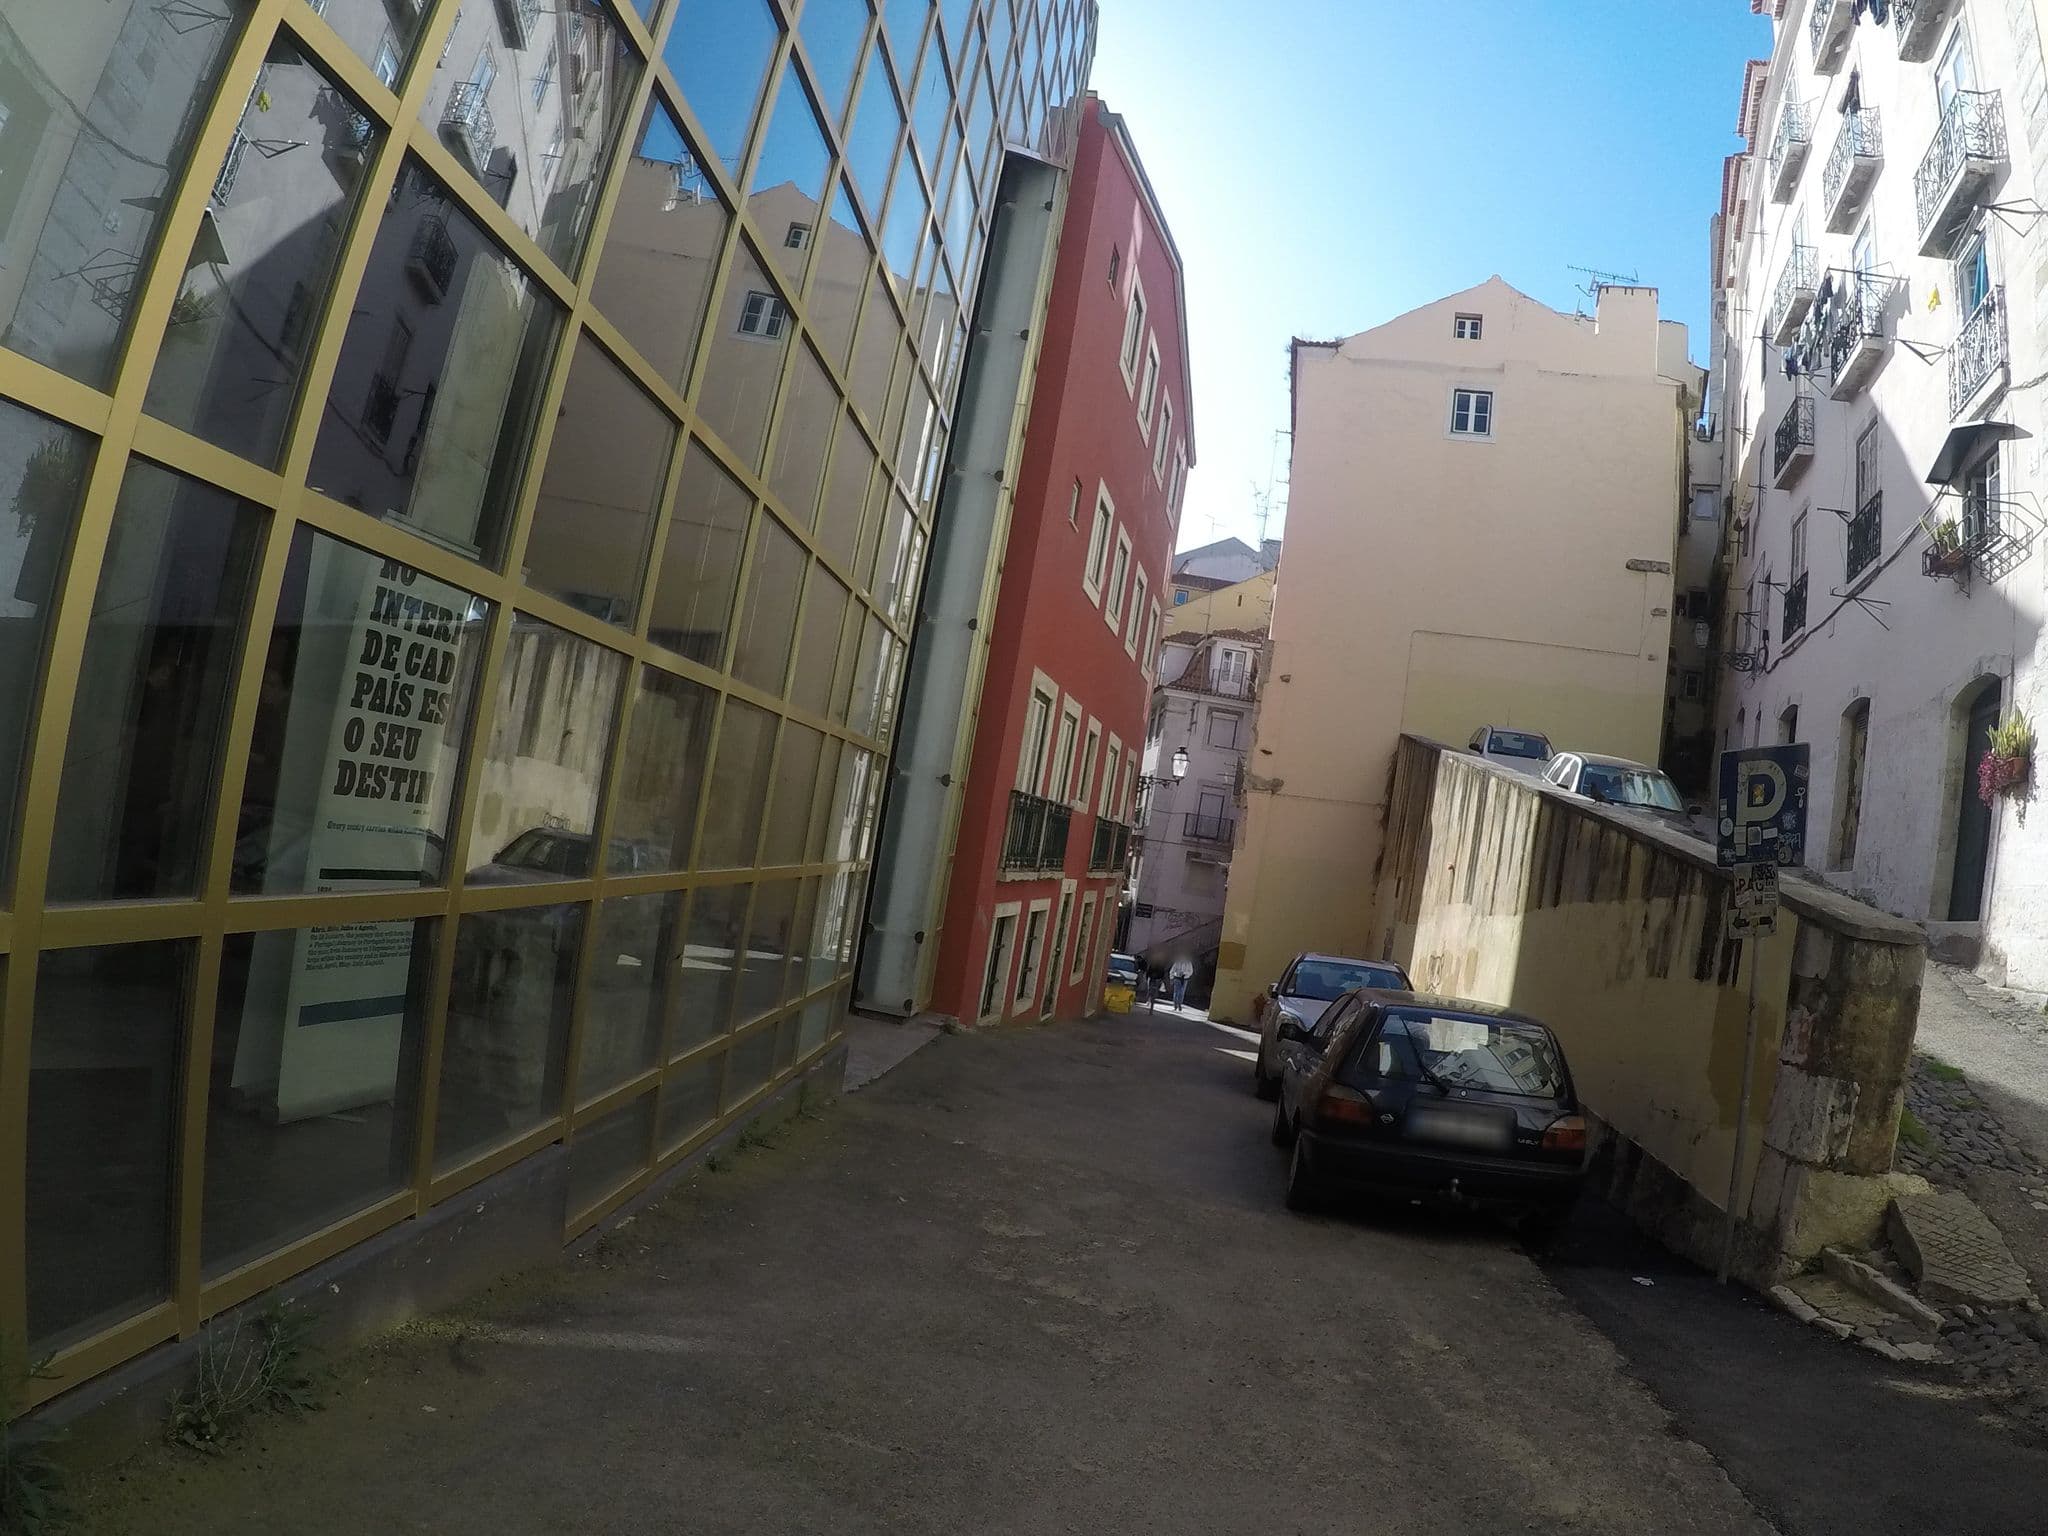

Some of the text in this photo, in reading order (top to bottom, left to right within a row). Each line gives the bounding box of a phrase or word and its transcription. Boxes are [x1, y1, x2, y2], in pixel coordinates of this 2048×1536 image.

[360, 628, 456, 684] DE CAD
[350, 672, 451, 725] PAÍS ES
[343, 717, 422, 762] O SEU
[1736, 760, 1787, 826] P
